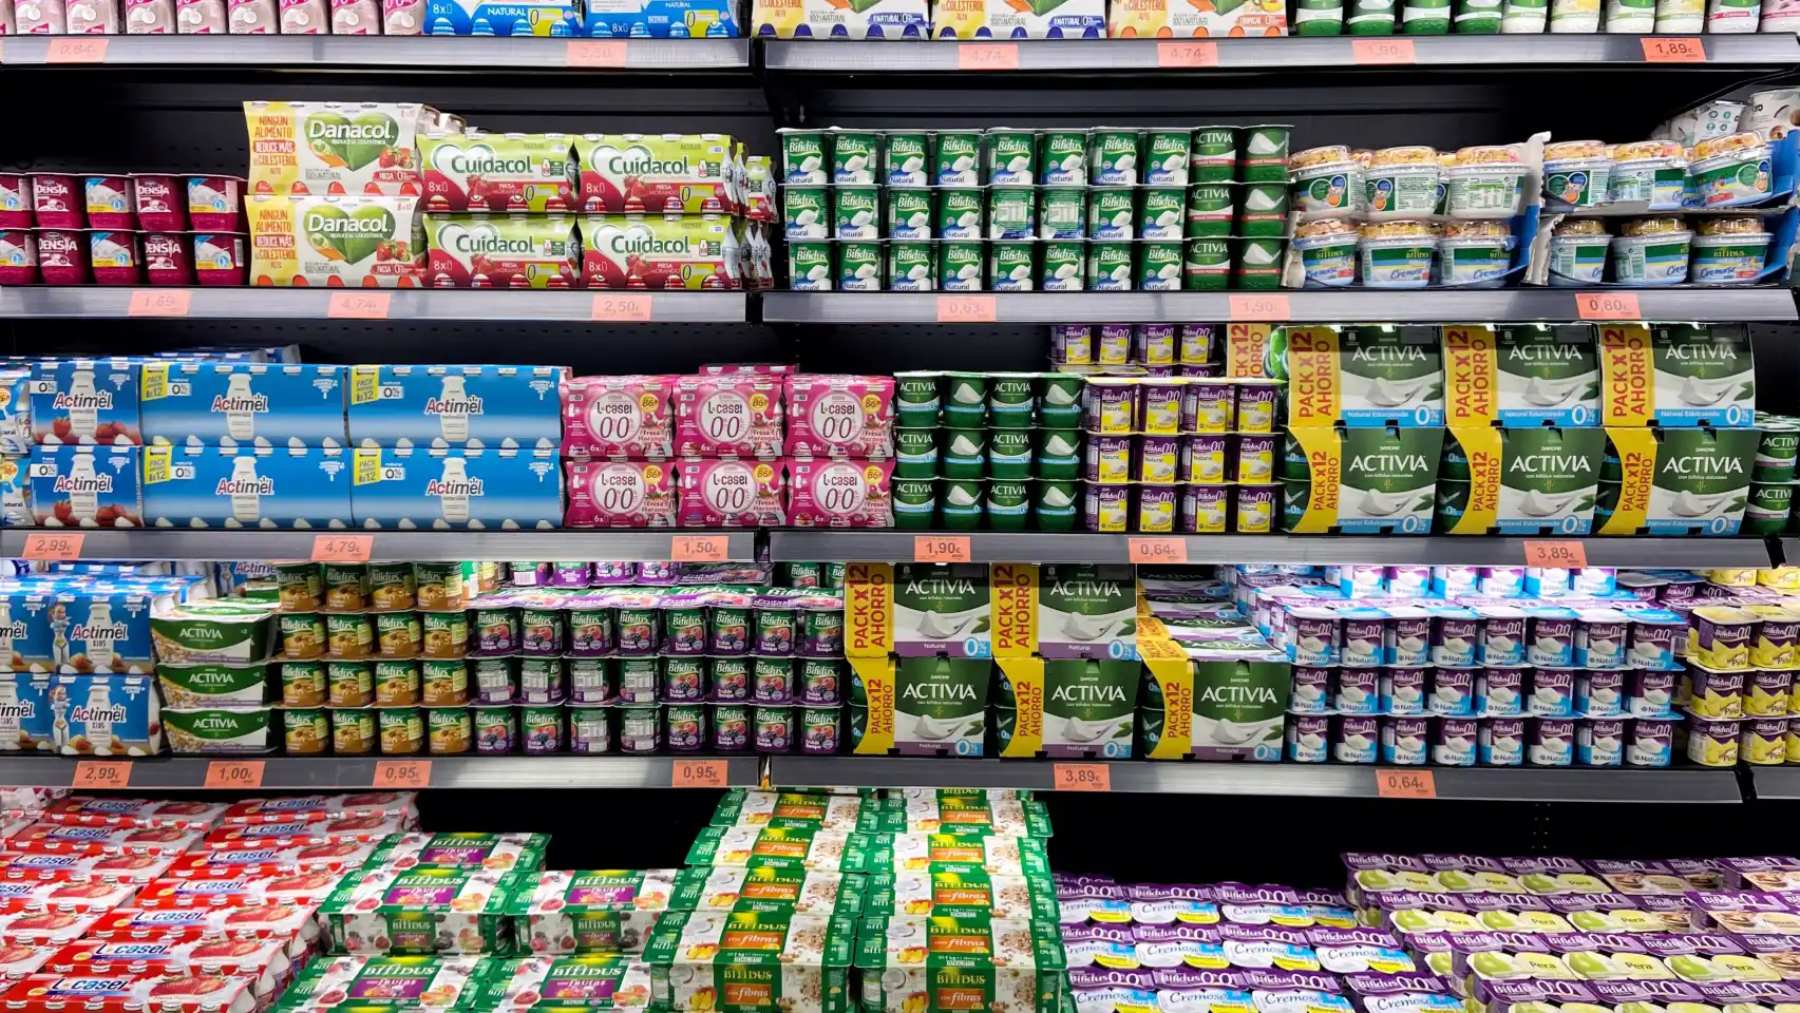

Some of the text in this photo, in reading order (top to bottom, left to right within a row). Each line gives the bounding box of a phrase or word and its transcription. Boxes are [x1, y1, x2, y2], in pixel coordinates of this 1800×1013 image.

[310, 120, 391, 138] Danacol
[1194, 132, 1232, 144] ACTIVIA
[452, 156, 532, 173] Cuidacol
[609, 156, 689, 174] Cuidacol
[1192, 189, 1230, 200] ACTIVIA
[308, 214, 387, 232] Danacol
[456, 235, 534, 252] Cuidacol
[611, 236, 689, 253] Cuidacol
[1191, 242, 1228, 252] ACTIVIA
[1352, 346, 1427, 361] ACTIVIA
[1509, 345, 1583, 360] ACTIVIA
[1666, 345, 1736, 360] ACTIVIA
[1316, 341, 1332, 416] AHORRO
[1472, 339, 1488, 416] AHORRO
[1628, 338, 1645, 415] AHORRO
[900, 382, 935, 393] ACTIVIA
[994, 382, 1030, 393] ACTIVIA
[1300, 369, 1314, 417] PACK
[1456, 367, 1470, 417] PACK
[1613, 369, 1627, 416] PACK
[56, 392, 112, 408] Actimel
[213, 395, 268, 412] Actimel
[426, 398, 482, 414] Actimel
[898, 434, 932, 445] ACTIVIA
[993, 434, 1028, 445] ACTIVIA
[1349, 455, 1428, 472] ACTIVIA
[1510, 456, 1591, 473] ACTIVIA
[1663, 457, 1743, 474] ACTIVIA
[56, 476, 112, 492] Actimel
[218, 478, 274, 494] Actimel
[428, 480, 483, 496] Actimel
[897, 484, 931, 495] ACTIVIA
[990, 485, 1026, 495] ACTIVIA
[1326, 458, 1339, 510] AHORRO
[1486, 458, 1499, 511] AHORRO
[1639, 458, 1652, 511] AHORRO
[1313, 476, 1327, 511] PACK
[1472, 477, 1487, 511] PACK
[1623, 480, 1636, 511] PACK
[906, 580, 976, 594] ACTIVIA
[1051, 581, 1121, 597] ACTIVIA
[871, 573, 885, 647] AHORRO
[1016, 574, 1030, 648] AHORRO
[72, 625, 128, 640] Actimel
[179, 629, 223, 639] ACTIVIA
[855, 607, 868, 648] PACK
[999, 607, 1012, 648] PACK
[189, 674, 234, 683] ACTIVIA
[903, 684, 976, 699] ACTIVIA
[1052, 686, 1126, 701] ACTIVIA
[1201, 687, 1277, 703] ACTIVIA
[72, 707, 126, 722] Actimel
[883, 685, 893, 733] AHORRO
[1031, 687, 1042, 736] AHORRO
[1179, 688, 1191, 737] AHORRO
[194, 718, 238, 728] ACTIVIA
[872, 704, 881, 734] PACK
[1019, 706, 1030, 736] PACK
[1168, 708, 1178, 738] PACK
